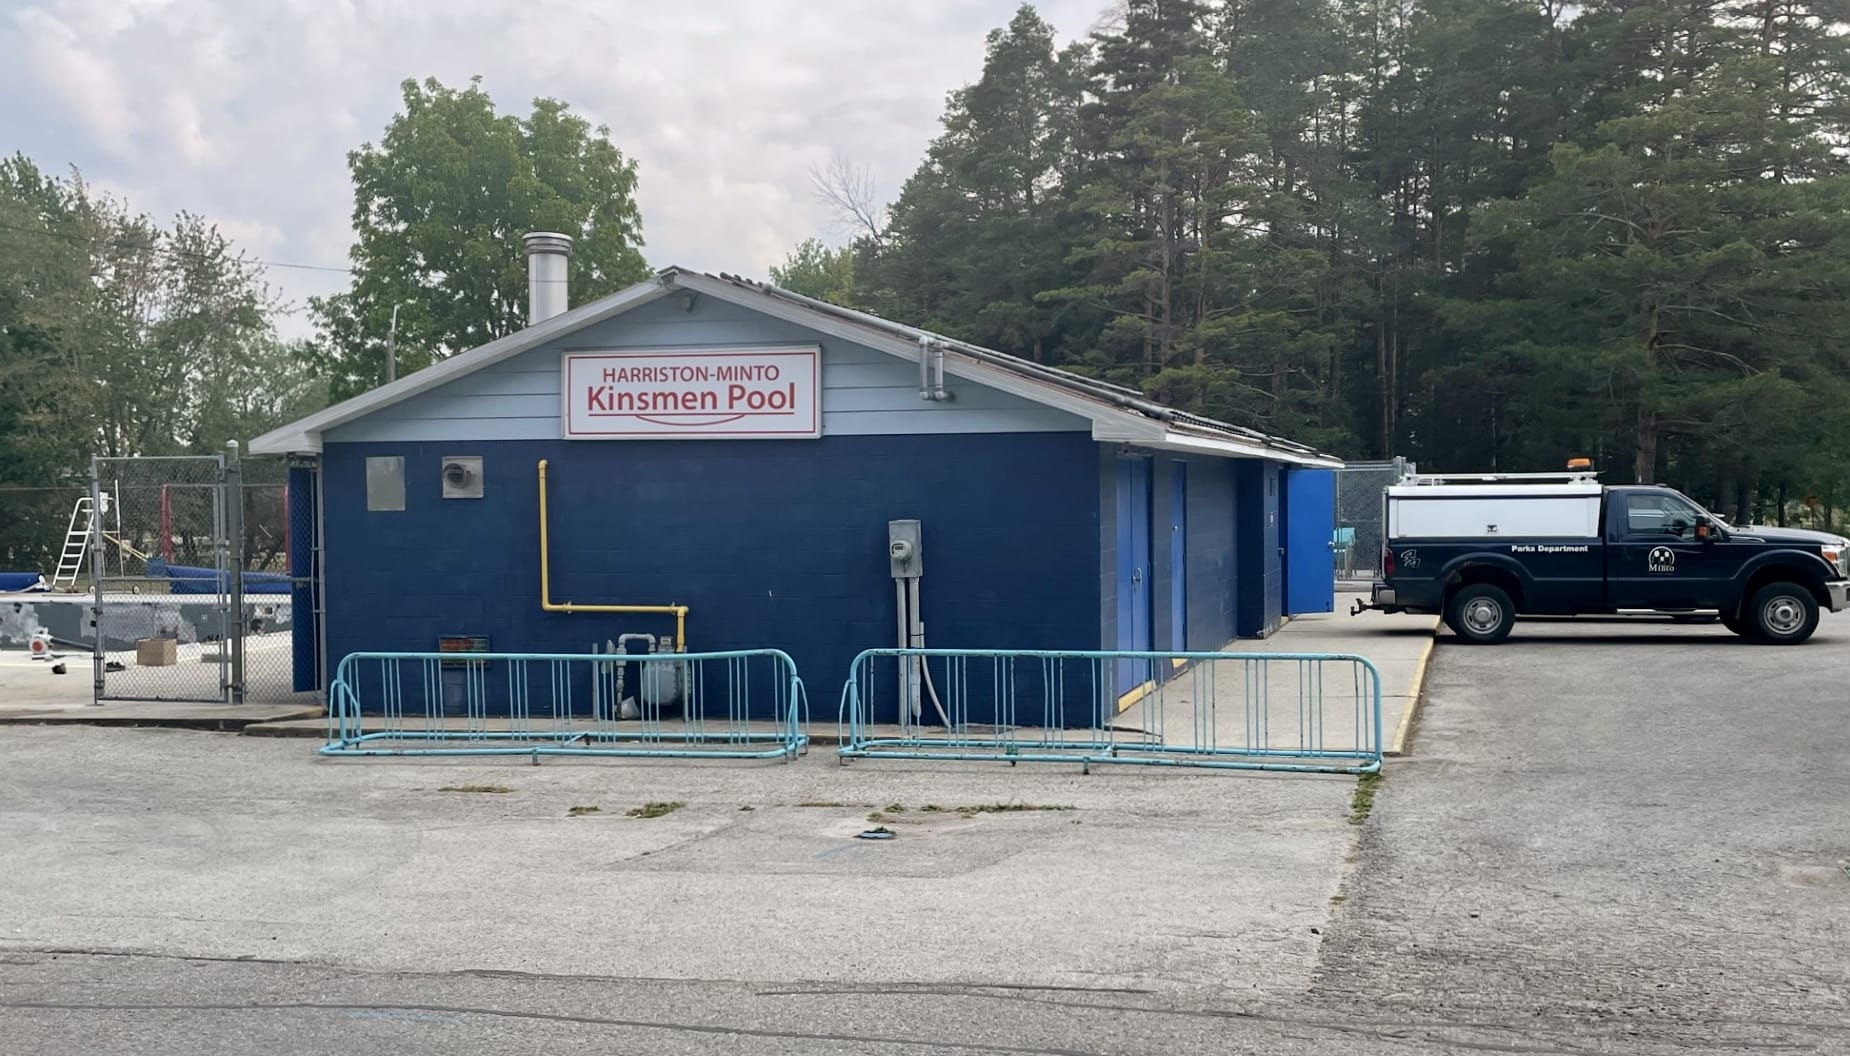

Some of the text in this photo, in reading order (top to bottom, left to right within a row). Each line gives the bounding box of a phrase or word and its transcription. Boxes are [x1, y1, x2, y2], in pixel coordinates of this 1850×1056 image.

[603, 365, 779, 382] HARRISTON-MINTO
[588, 382, 795, 411] Kinsmen Pool
[1511, 545, 1588, 553] Parks Department
[1649, 563, 1675, 572] Minto
